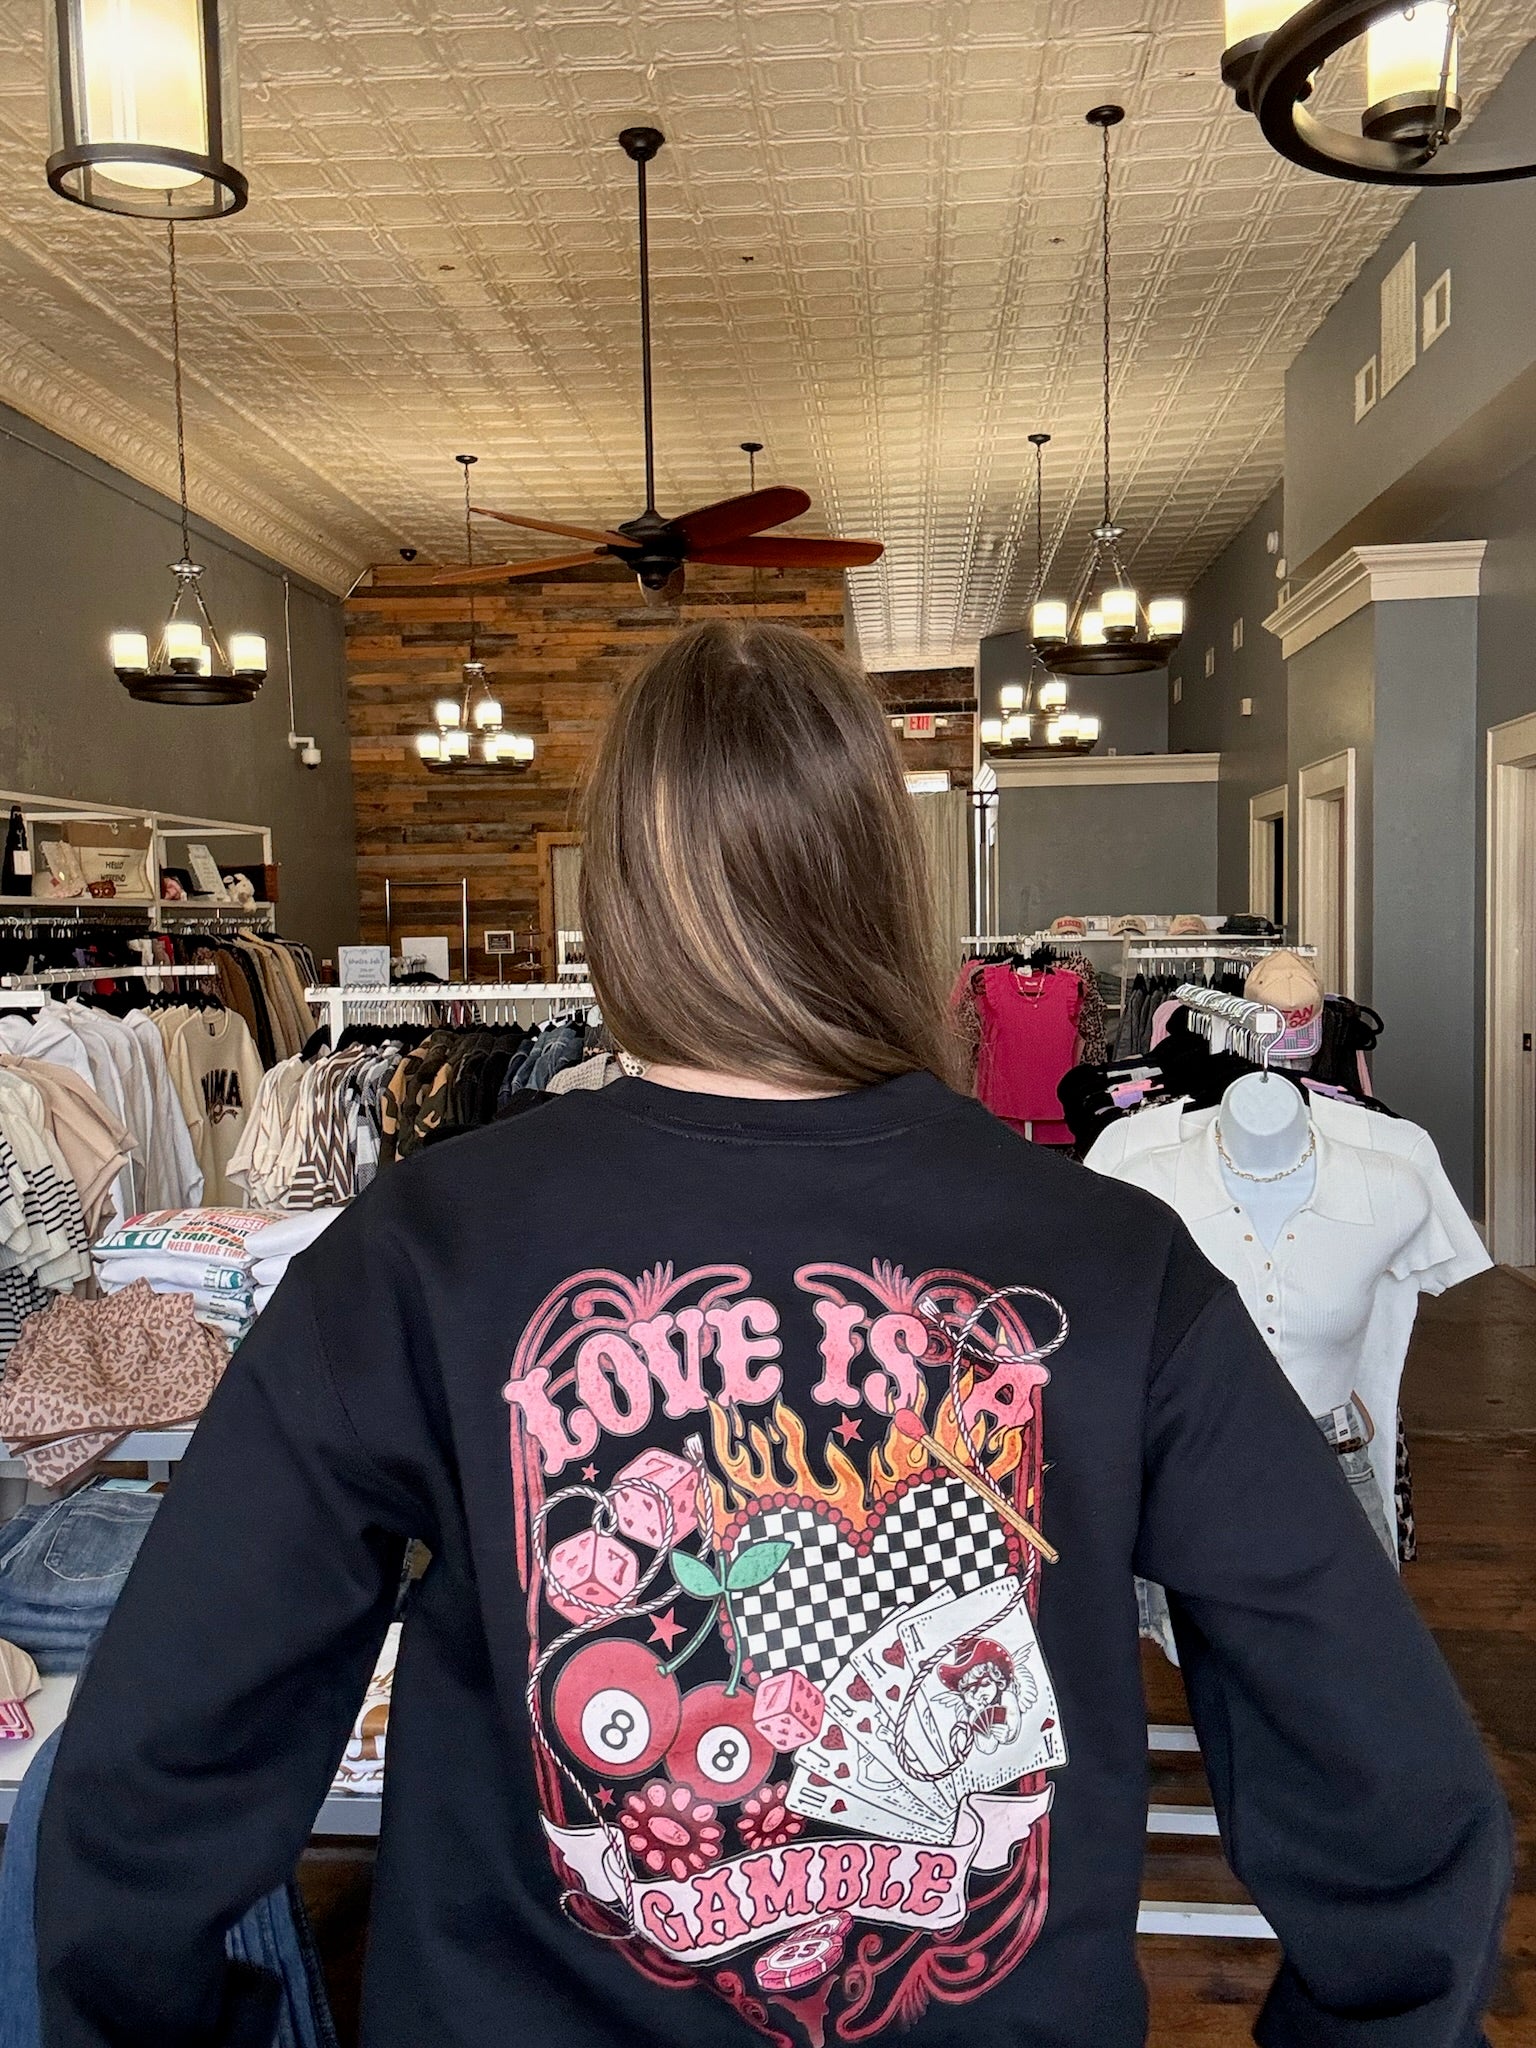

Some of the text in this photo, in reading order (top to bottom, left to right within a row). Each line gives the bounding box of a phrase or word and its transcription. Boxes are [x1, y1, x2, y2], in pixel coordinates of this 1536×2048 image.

[910, 716, 929, 730] EXIT
[134, 1230, 168, 1247] TO
[171, 1230, 218, 1243] START
[207, 1221, 238, 1233] KNOW
[238, 1229, 250, 1237] IT
[166, 1241, 248, 1260] NEED MORE TIME
[502, 1297, 1051, 1477] LOVE IS A
[909, 1623, 926, 1653] A
[863, 1648, 887, 1679] K
[829, 1694, 857, 1718] Q
[600, 1709, 635, 1750] 8
[711, 1739, 739, 1772] 8
[807, 1746, 831, 1768] J
[798, 1786, 828, 1809] 10
[641, 1844, 957, 1951] GAMBLE
[777, 1941, 823, 1962] 25
